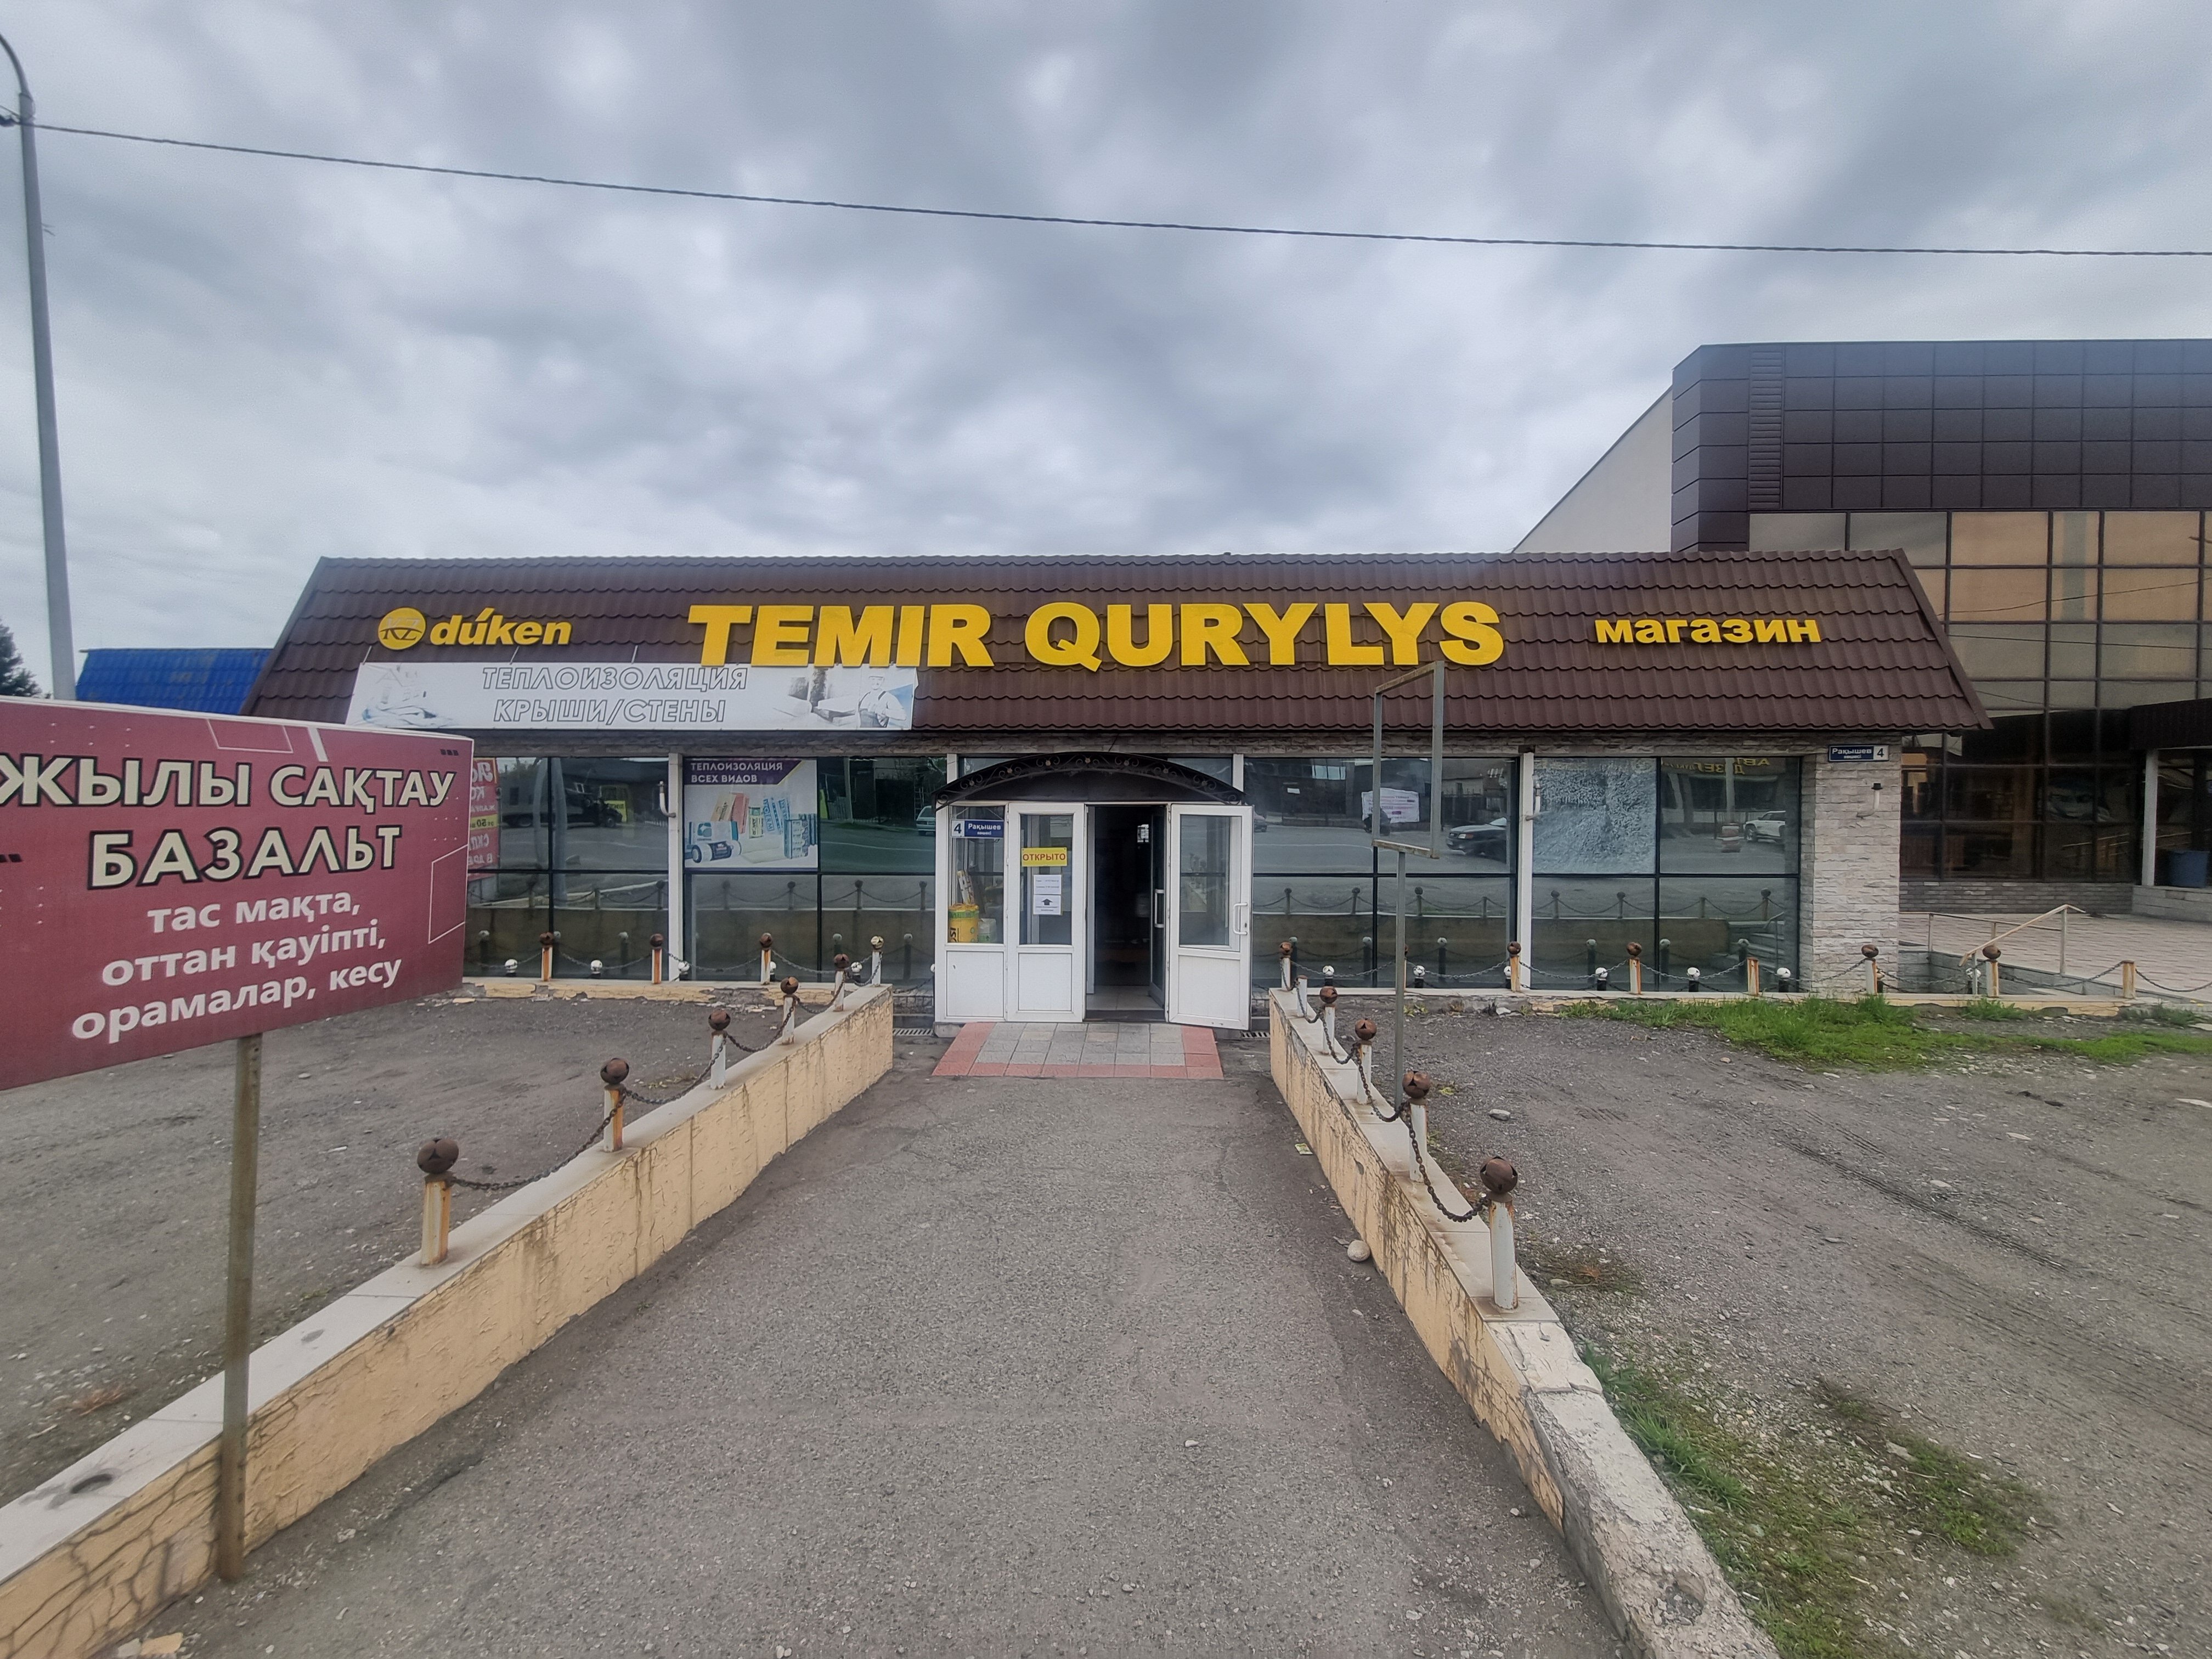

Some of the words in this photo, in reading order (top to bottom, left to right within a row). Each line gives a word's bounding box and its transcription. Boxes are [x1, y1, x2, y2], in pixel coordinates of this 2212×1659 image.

[687, 603, 994, 668] TEMIR
[1024, 601, 1504, 672] QURYLYS
[1594, 618, 1821, 644] магазин
[482, 667, 748, 692] ТЕПЛОИЗОЛЯЦИЯ
[493, 698, 726, 725] КРЫШИ/СТЕНЫ
[1877, 747, 1884, 758] 4
[691, 762, 783, 771] ТЕПЛОИЗОЛЯЦИЯ
[691, 775, 719, 783] ВСЕХ
[721, 775, 758, 783] ВИДОВ
[0, 753, 252, 807] ЖЫЛЫ
[268, 765, 458, 815] САҚТАУ
[953, 823, 962, 834] 4
[87, 825, 403, 890] БАЗАЛЬТ
[147, 902, 221, 934] тас
[235, 891, 360, 924] мақта,
[101, 946, 236, 986] оттан
[251, 918, 386, 969] қауіпті,
[71, 974, 316, 1044] орамалар,
[330, 958, 402, 991] кесу
